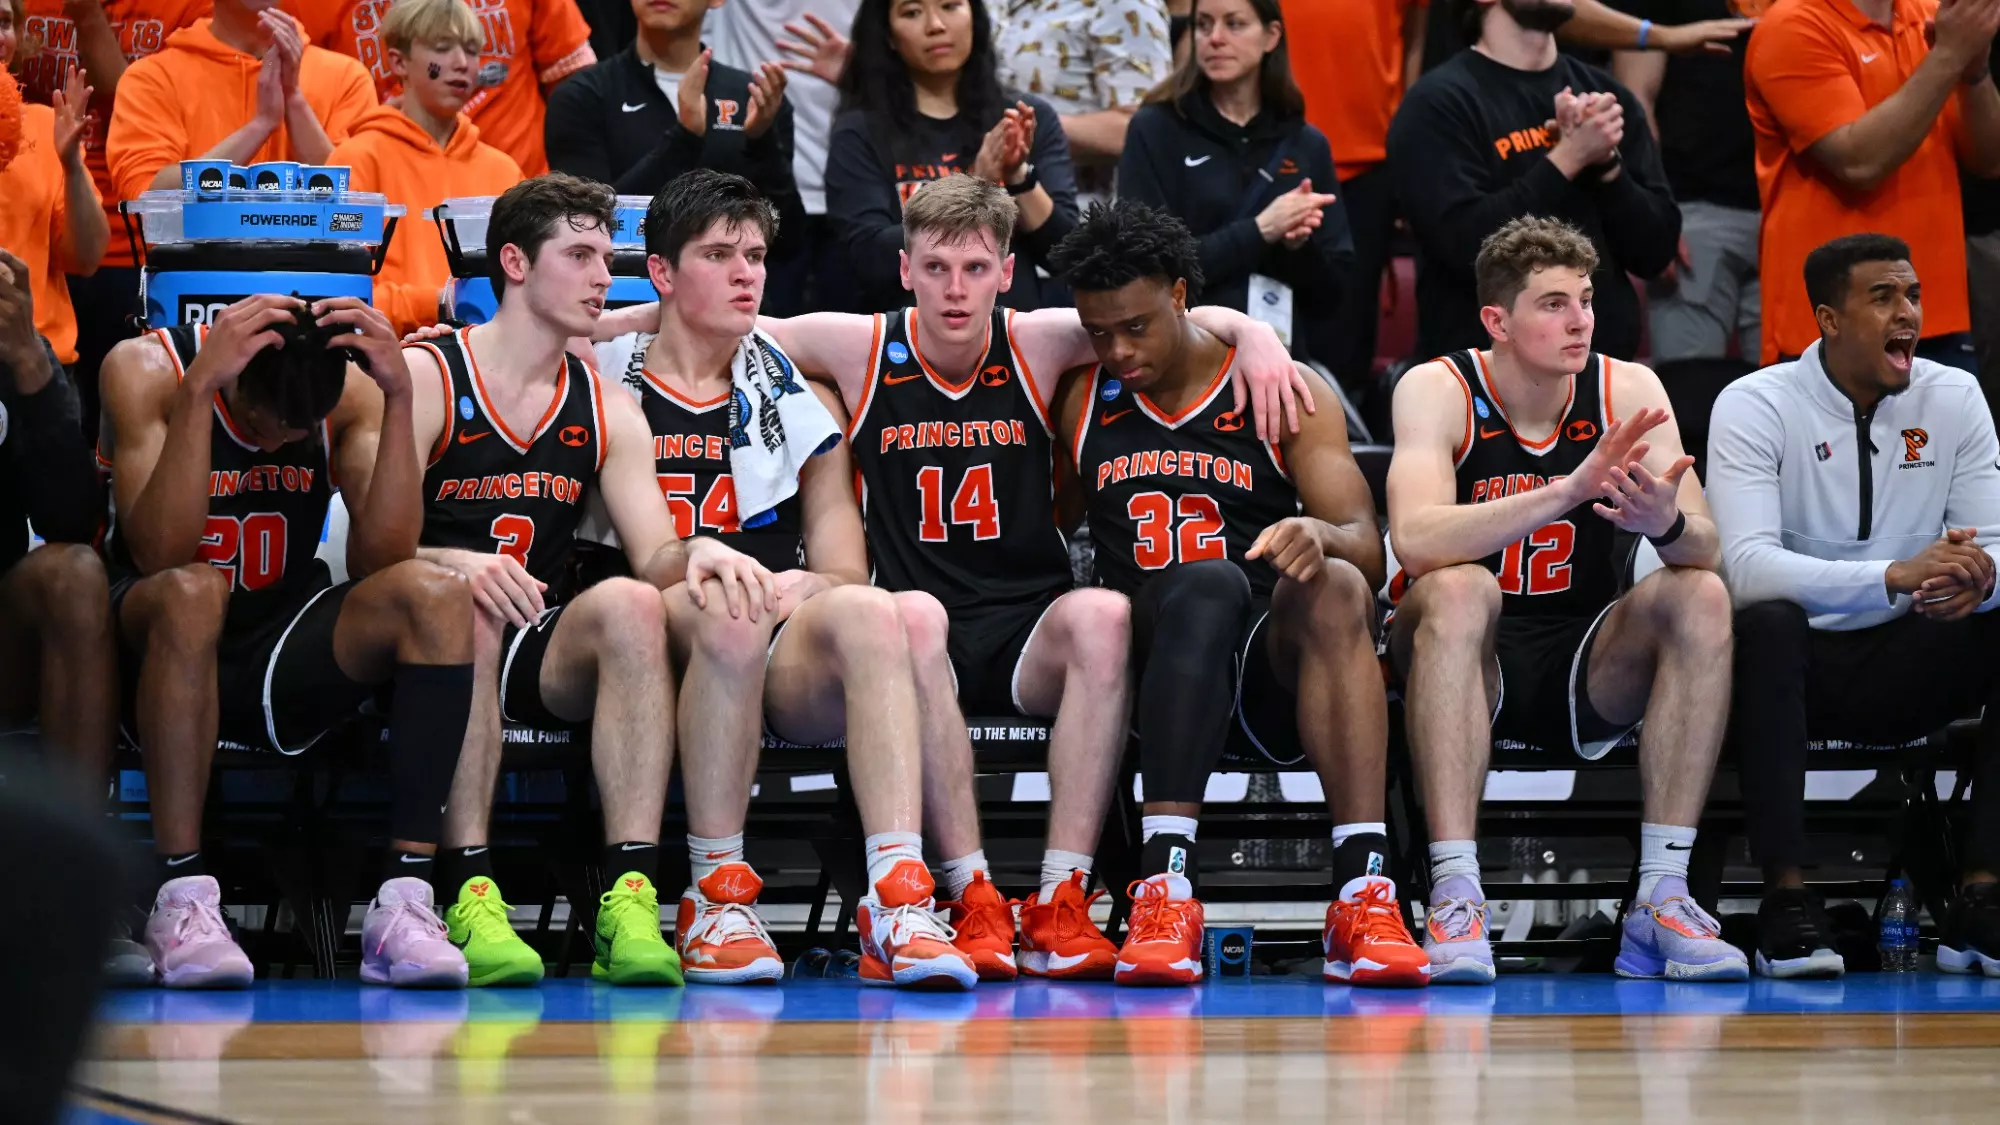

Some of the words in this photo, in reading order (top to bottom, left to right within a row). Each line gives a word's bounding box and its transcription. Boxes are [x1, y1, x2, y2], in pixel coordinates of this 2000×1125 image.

[714, 98, 740, 125] P
[201, 180, 223, 188] NCAA
[240, 213, 318, 227] POWERADE
[881, 419, 1027, 455] PRINCETON
[1900, 427, 1930, 462] P
[208, 464, 315, 497] INCETON
[1097, 449, 1253, 492] PRINCETON
[1898, 460, 1936, 471] PRINCETON
[435, 471, 583, 506] PRINCETON
[656, 473, 743, 537] 54
[916, 462, 1001, 543] 14
[489, 512, 535, 574] 3
[1126, 490, 1228, 570] 32
[192, 511, 288, 593] 20
[1495, 519, 1577, 596] 12
[502, 729, 535, 743] FINAL
[537, 730, 570, 743] FOUR
[984, 727, 1007, 741] THE
[1008, 727, 1047, 741] MEN'S
[1223, 946, 1245, 954] NCAA
